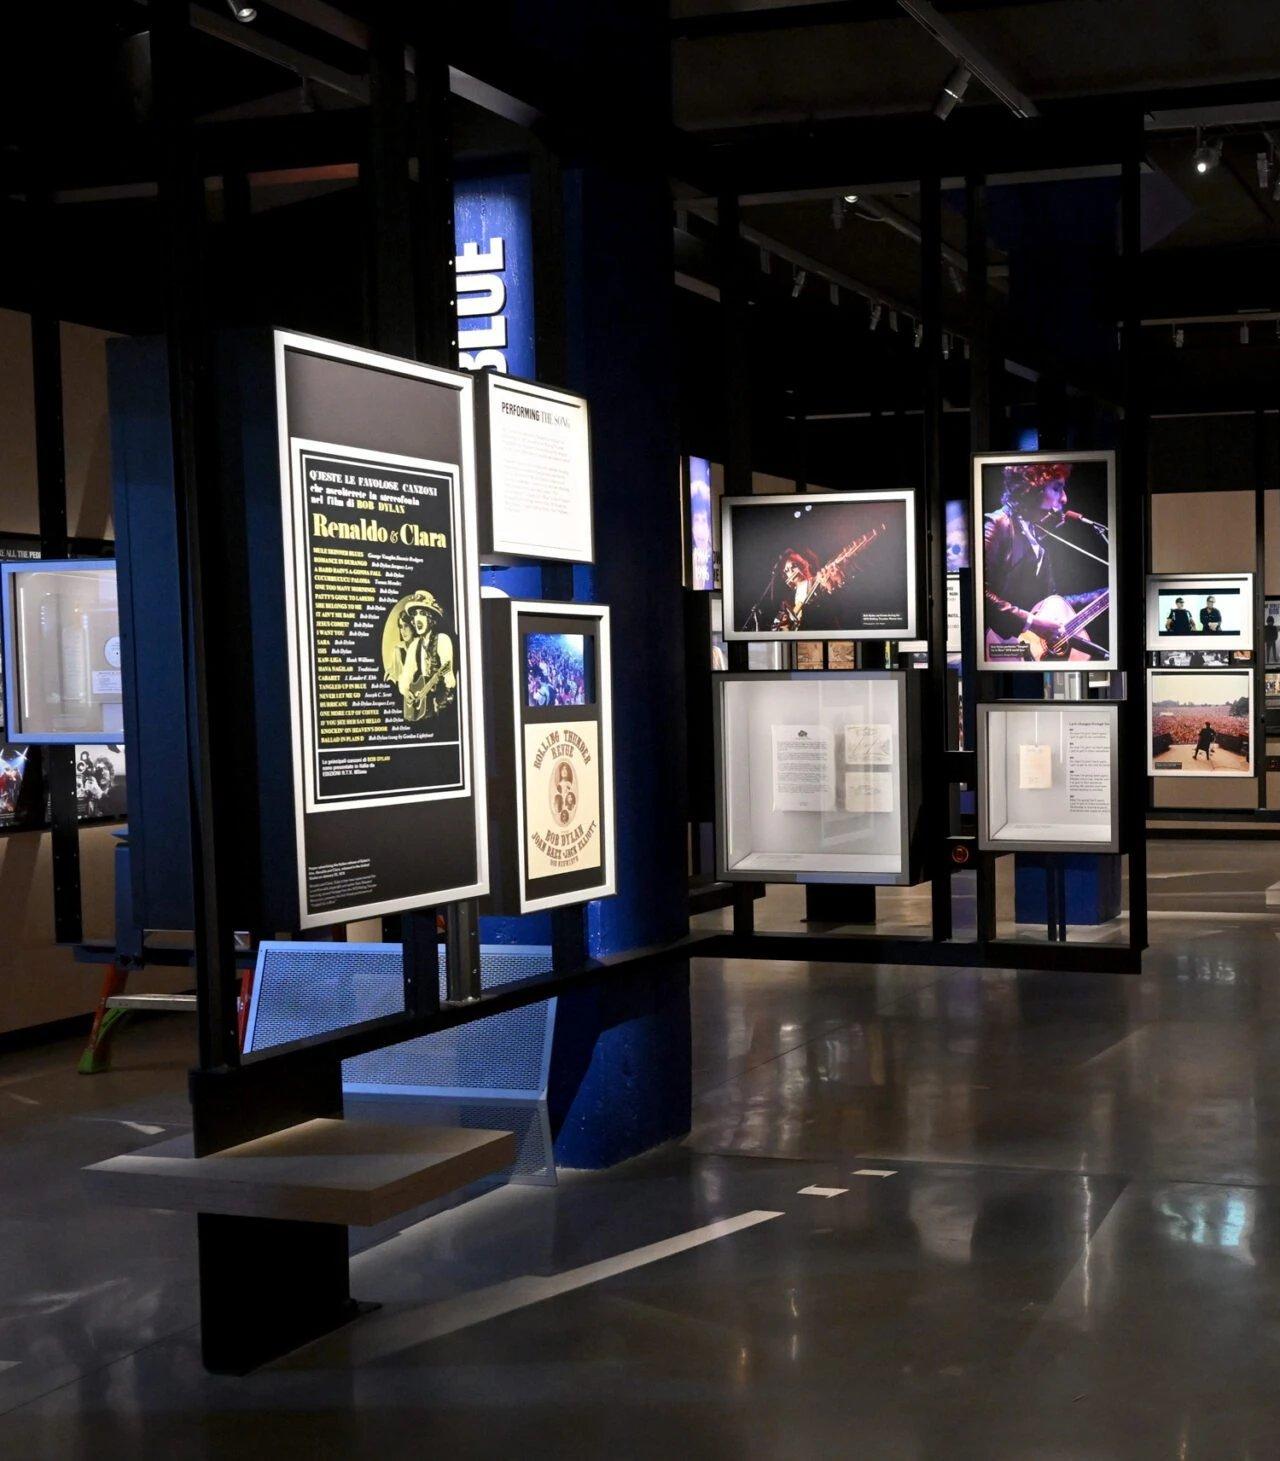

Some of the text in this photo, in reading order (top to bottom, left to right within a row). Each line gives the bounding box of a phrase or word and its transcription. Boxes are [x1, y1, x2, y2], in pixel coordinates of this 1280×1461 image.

[456, 237, 508, 374] BLUE
[501, 402, 540, 421] PERFORMING
[540, 410, 553, 425] THE
[345, 474, 356, 485] LE
[358, 476, 399, 491] FAVOLOSE
[402, 483, 438, 496] CANZONI
[327, 495, 344, 506] film
[346, 497, 354, 507] di
[356, 499, 374, 510] BOB
[379, 502, 405, 514] DYLAN
[312, 513, 447, 548] Renaldo & Clara
[533, 730, 591, 770] ROLLING THUNDER
[551, 744, 574, 760] REVUE
[531, 832, 547, 852] JOAN
[545, 824, 584, 846] BOB DYLAN
